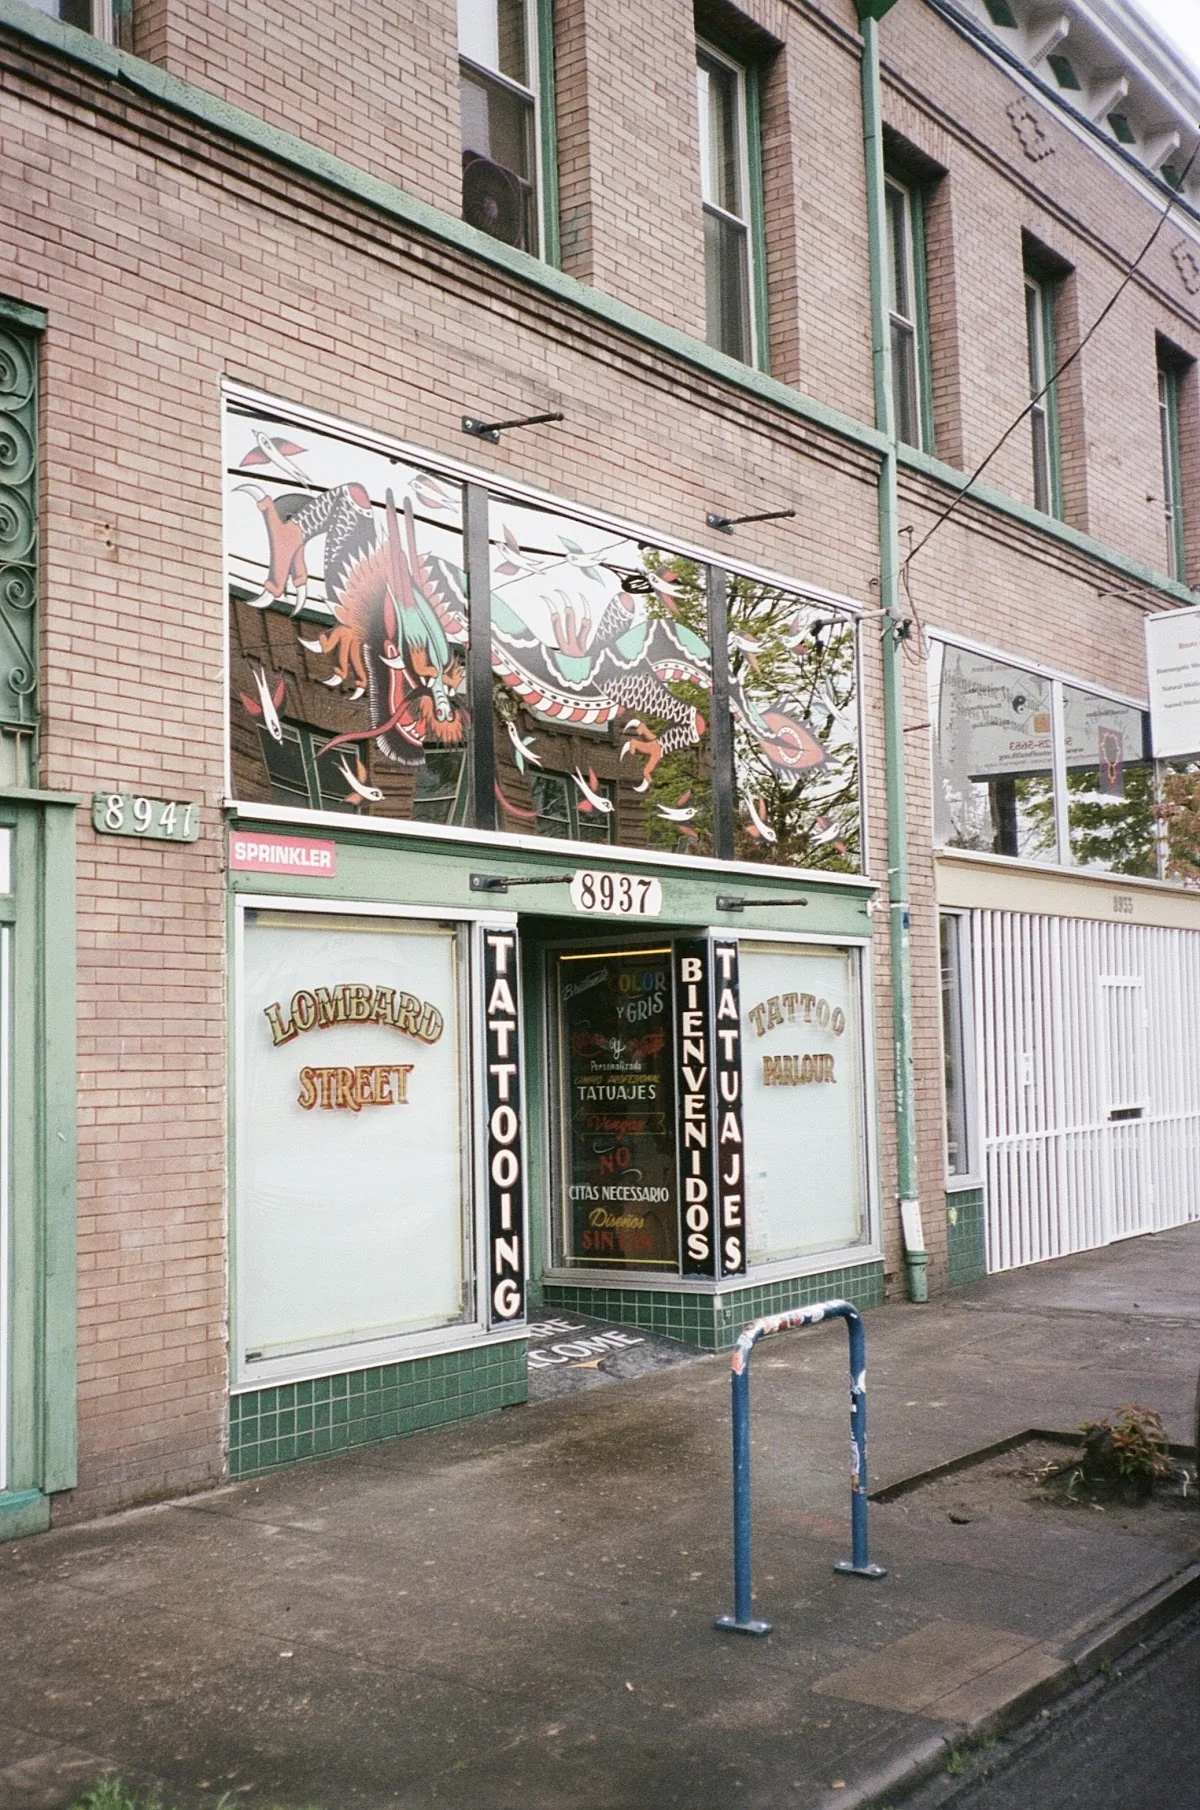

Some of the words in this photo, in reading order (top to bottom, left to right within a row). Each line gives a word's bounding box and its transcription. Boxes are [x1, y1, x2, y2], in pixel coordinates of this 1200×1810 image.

[235, 841, 332, 869] SPRINKLER
[580, 873, 652, 914] 8937
[607, 971, 667, 992] COLOR
[263, 982, 444, 1047] LOMBARD
[627, 992, 664, 1023] GRIS
[748, 992, 846, 1038] TATTOO
[762, 1053, 837, 1087] PARLOUR
[297, 1063, 414, 1113] STREET
[577, 1085, 656, 1101] TATUAJES
[681, 957, 710, 1261] BIENVENIDOS
[716, 947, 742, 1271] TATUAJES
[487, 935, 521, 1319] TATTOOING
[598, 1147, 632, 1175] NO
[569, 1185, 599, 1201] CITAS
[602, 1186, 670, 1203] NECESSARIO
[582, 1230, 615, 1249] SIN
